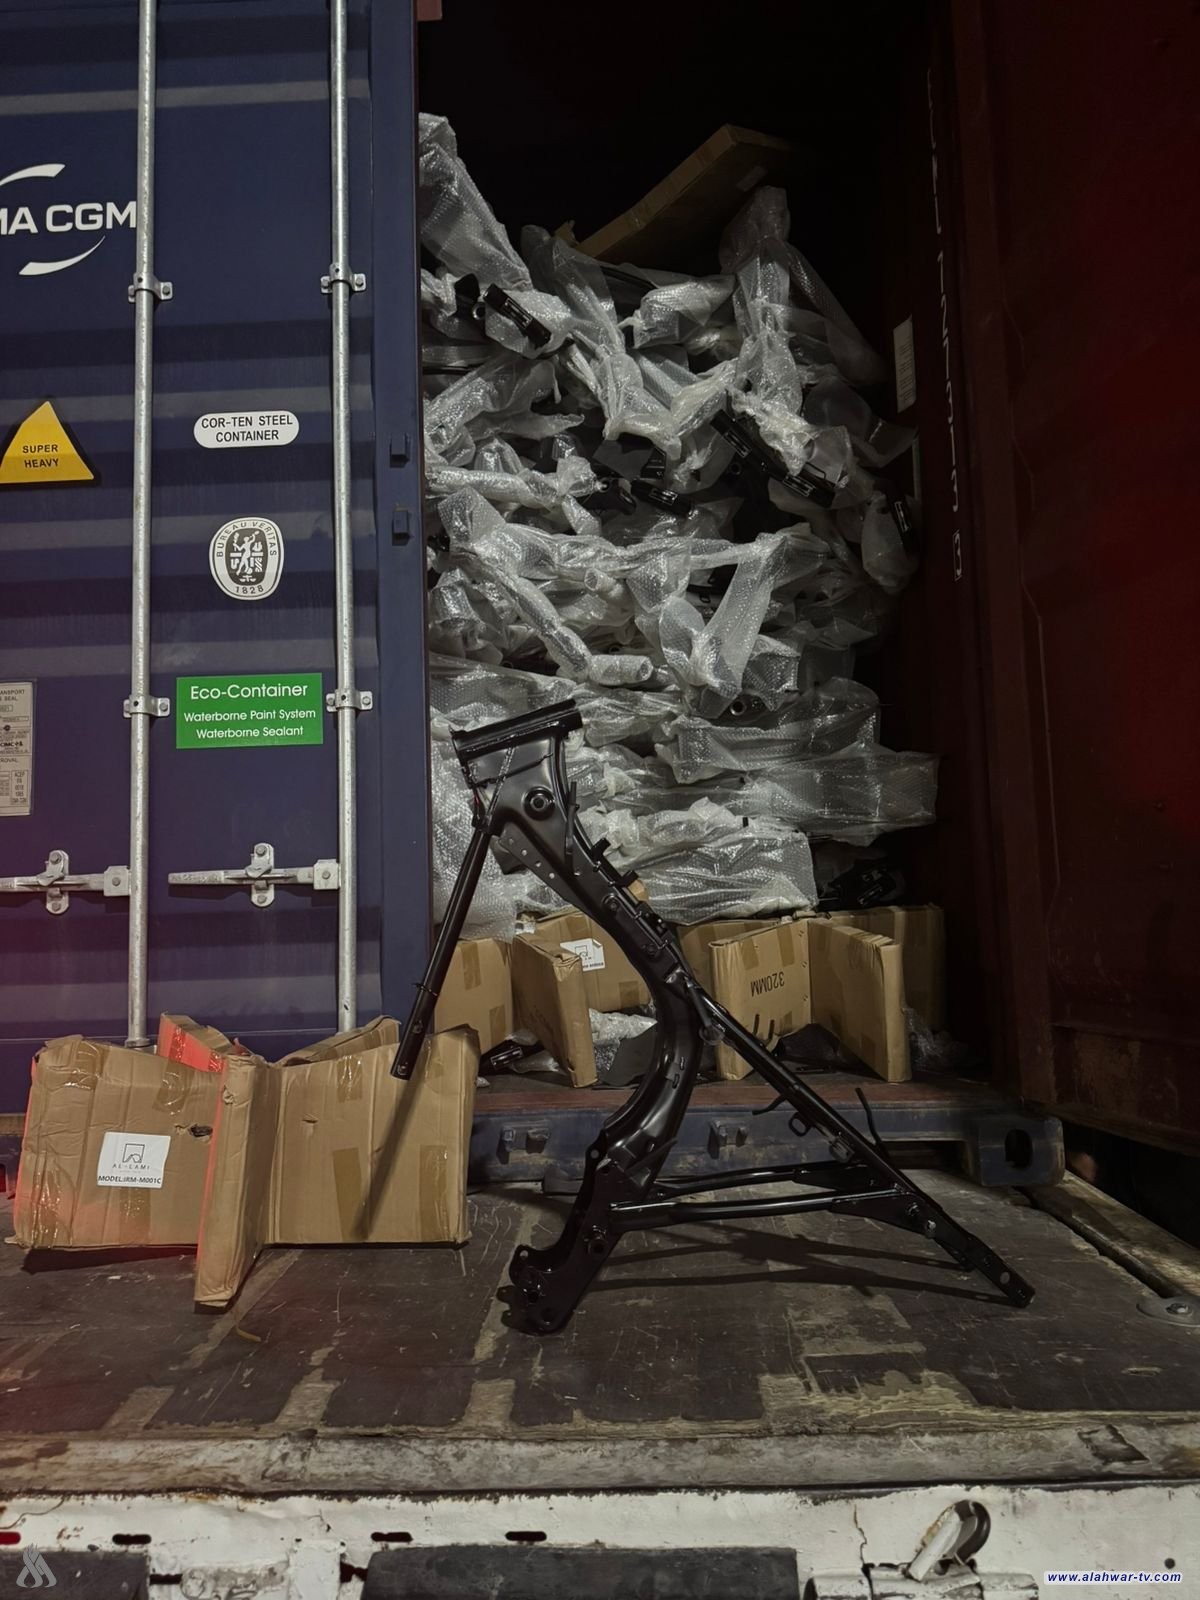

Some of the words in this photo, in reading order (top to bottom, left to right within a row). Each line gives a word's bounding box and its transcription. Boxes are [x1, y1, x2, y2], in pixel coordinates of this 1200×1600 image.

[0, 206, 38, 236] A
[46, 200, 137, 233] CGM
[201, 416, 253, 429] COR-TEN
[258, 414, 293, 426] STEEL
[215, 429, 279, 443] CONTAINER
[22, 444, 58, 454] SUPER
[24, 458, 59, 468] HEAVY
[216, 521, 247, 558] BUREAU
[252, 521, 277, 556] VERITAS
[235, 585, 264, 595] 1828
[0, 688, 25, 696] ANSPORT
[190, 682, 308, 700] Eco-Container
[184, 711, 248, 723] Waterborne
[250, 709, 277, 720] Paint
[279, 709, 316, 721] System
[196, 727, 260, 739] Waterborne
[262, 725, 304, 738] Sealant
[750, 971, 785, 998] 320MM
